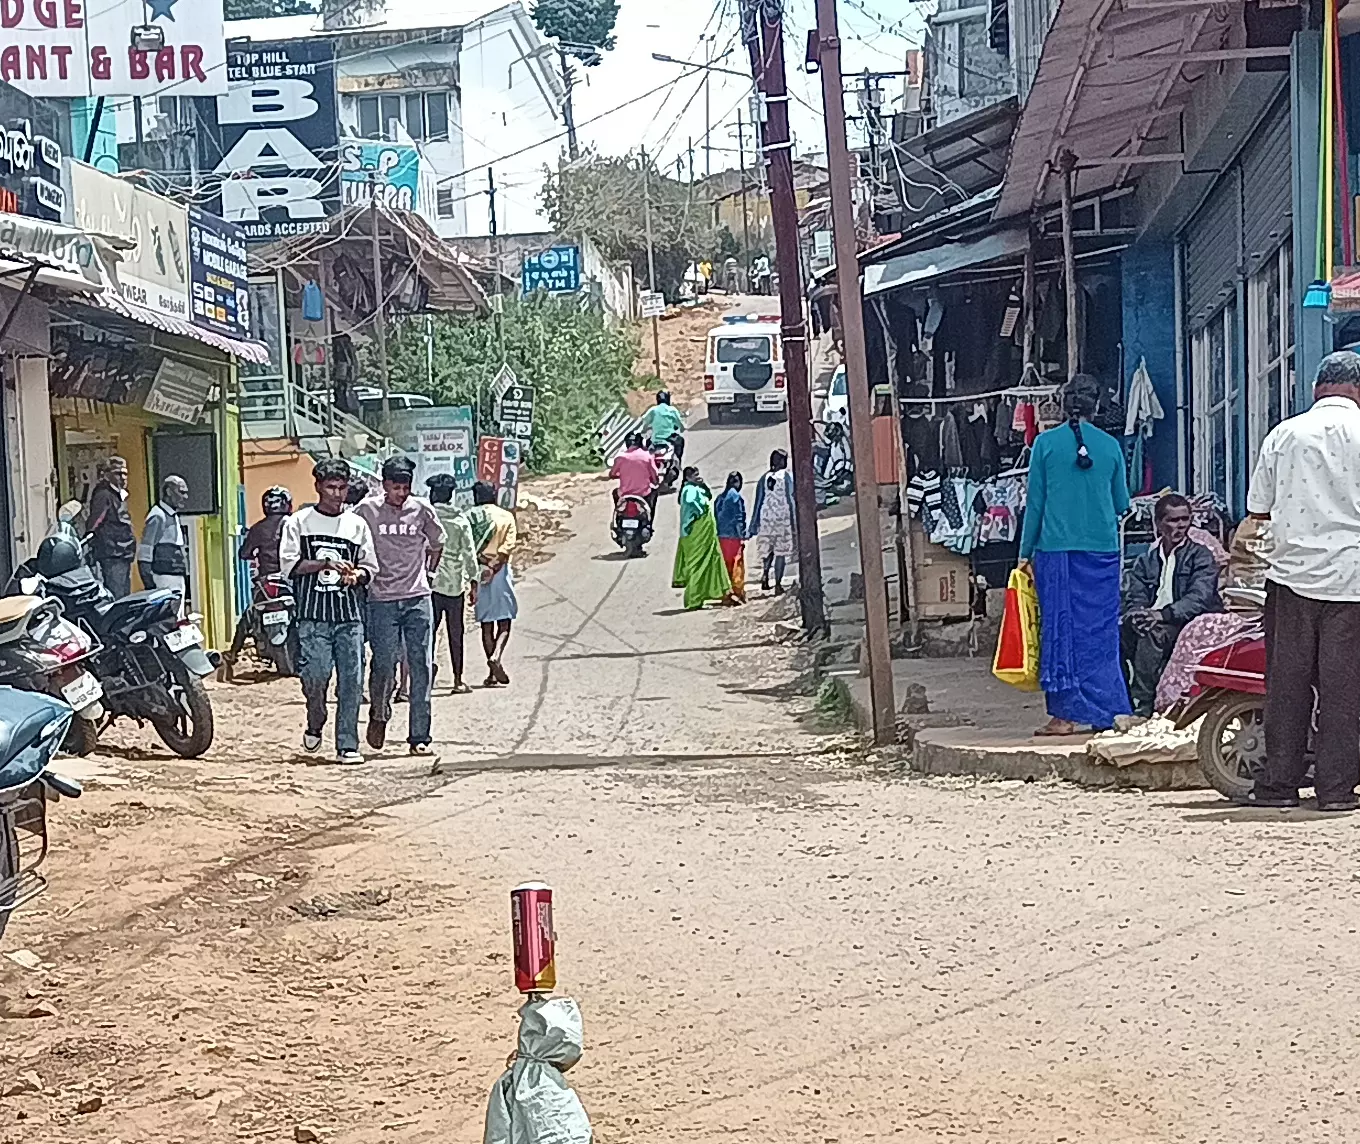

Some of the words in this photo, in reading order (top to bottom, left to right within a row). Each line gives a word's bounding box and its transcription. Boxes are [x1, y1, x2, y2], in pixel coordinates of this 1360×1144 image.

[91, 46, 111, 80] &
[128, 45, 207, 83] BAR
[263, 51, 289, 64] HILL
[228, 67, 249, 79] TEL
[213, 79, 328, 221] BAR
[244, 223, 271, 237] ARDS
[274, 221, 329, 236] ACCEPTED
[423, 441, 464, 452] XEROX
